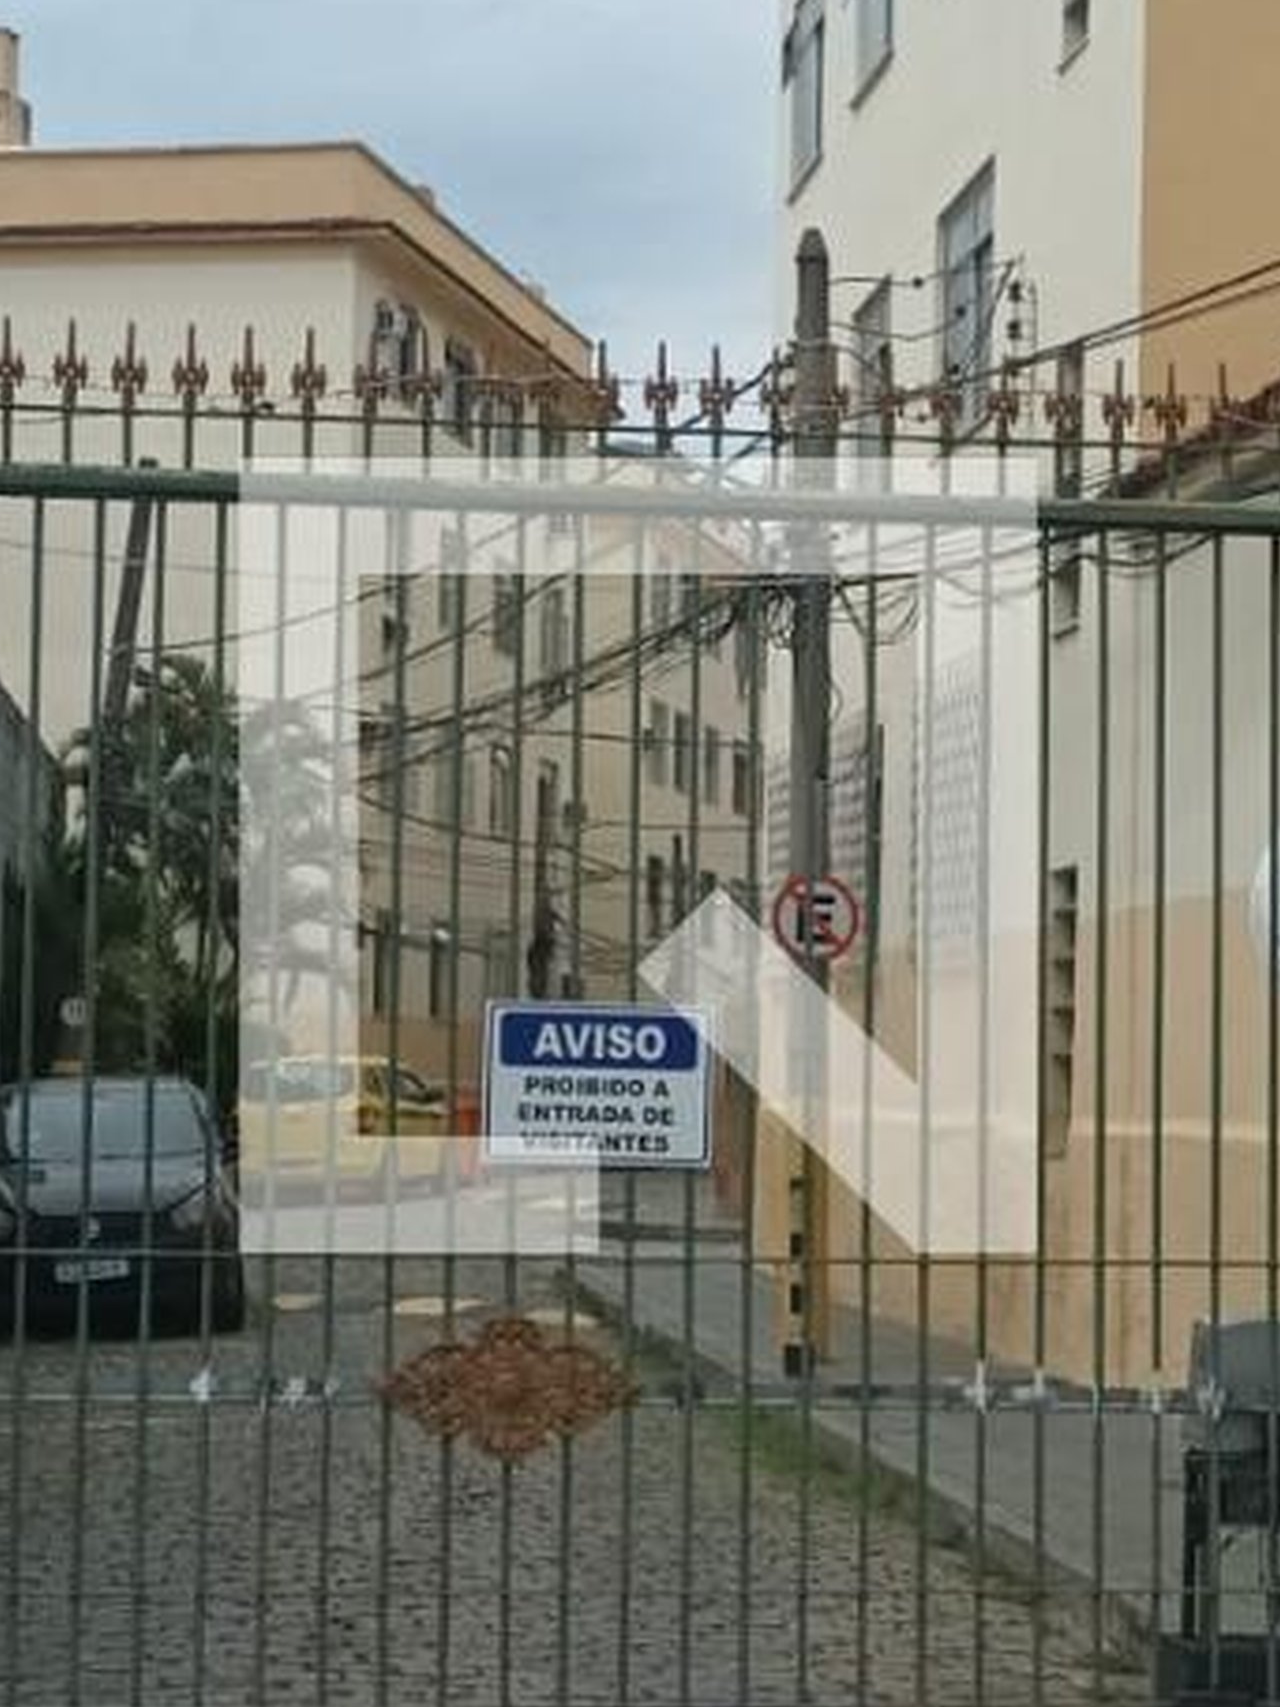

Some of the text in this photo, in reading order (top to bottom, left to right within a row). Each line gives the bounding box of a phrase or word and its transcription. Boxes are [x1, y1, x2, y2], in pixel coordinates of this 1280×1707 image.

[532, 1022, 667, 1062] AVISO
[524, 1074, 670, 1098] PROIBIDO A
[518, 1102, 674, 1127] ENTRADA DE
